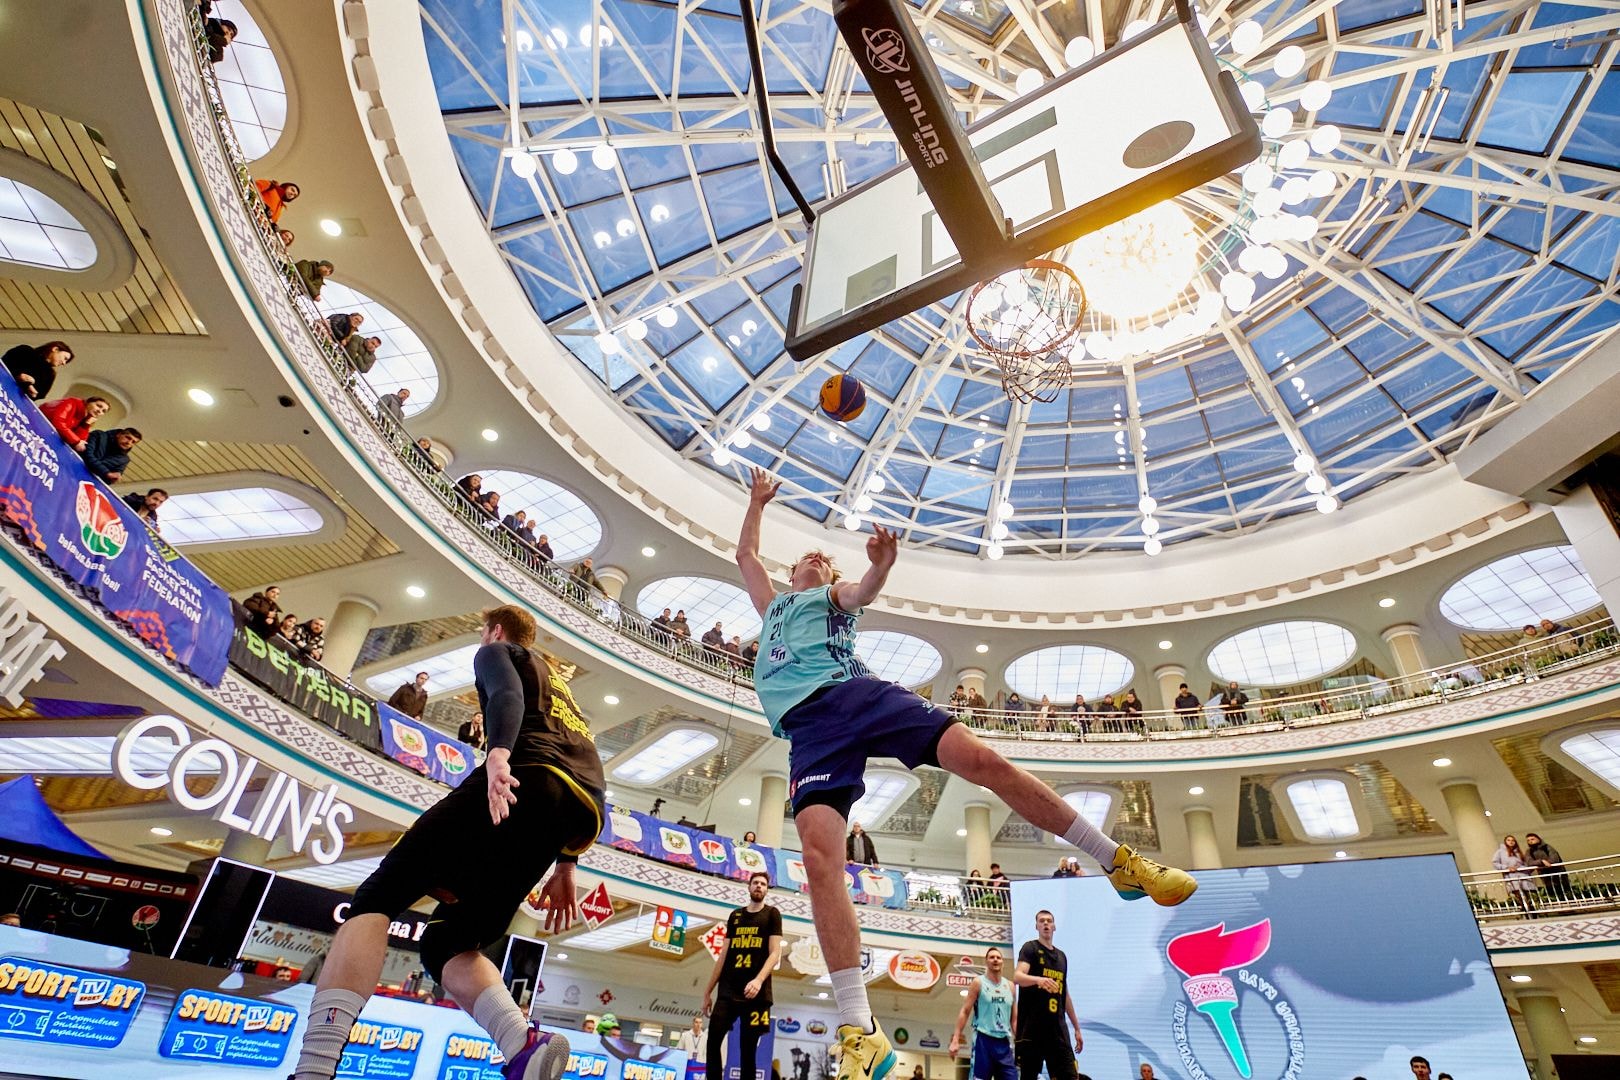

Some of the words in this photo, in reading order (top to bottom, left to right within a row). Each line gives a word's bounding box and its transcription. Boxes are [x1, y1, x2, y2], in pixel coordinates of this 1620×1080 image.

[895, 79, 949, 165] JINLING
[912, 131, 936, 169] SPORTS
[142, 569, 202, 624] FEDERATION
[244, 625, 372, 728] BETERA
[111, 714, 354, 865] COLIN'S
[581, 901, 612, 916] пикант
[731, 934, 763, 949] POWER
[735, 954, 752, 968] 24
[1238, 969, 1278, 1001] КЛУБ
[1048, 998, 1058, 1013] 6
[56, 1011, 120, 1027] Спортивные
[750, 1011, 770, 1026] 24
[52, 1021, 95, 1032] онлайн
[49, 1028, 118, 1042] трансляции
